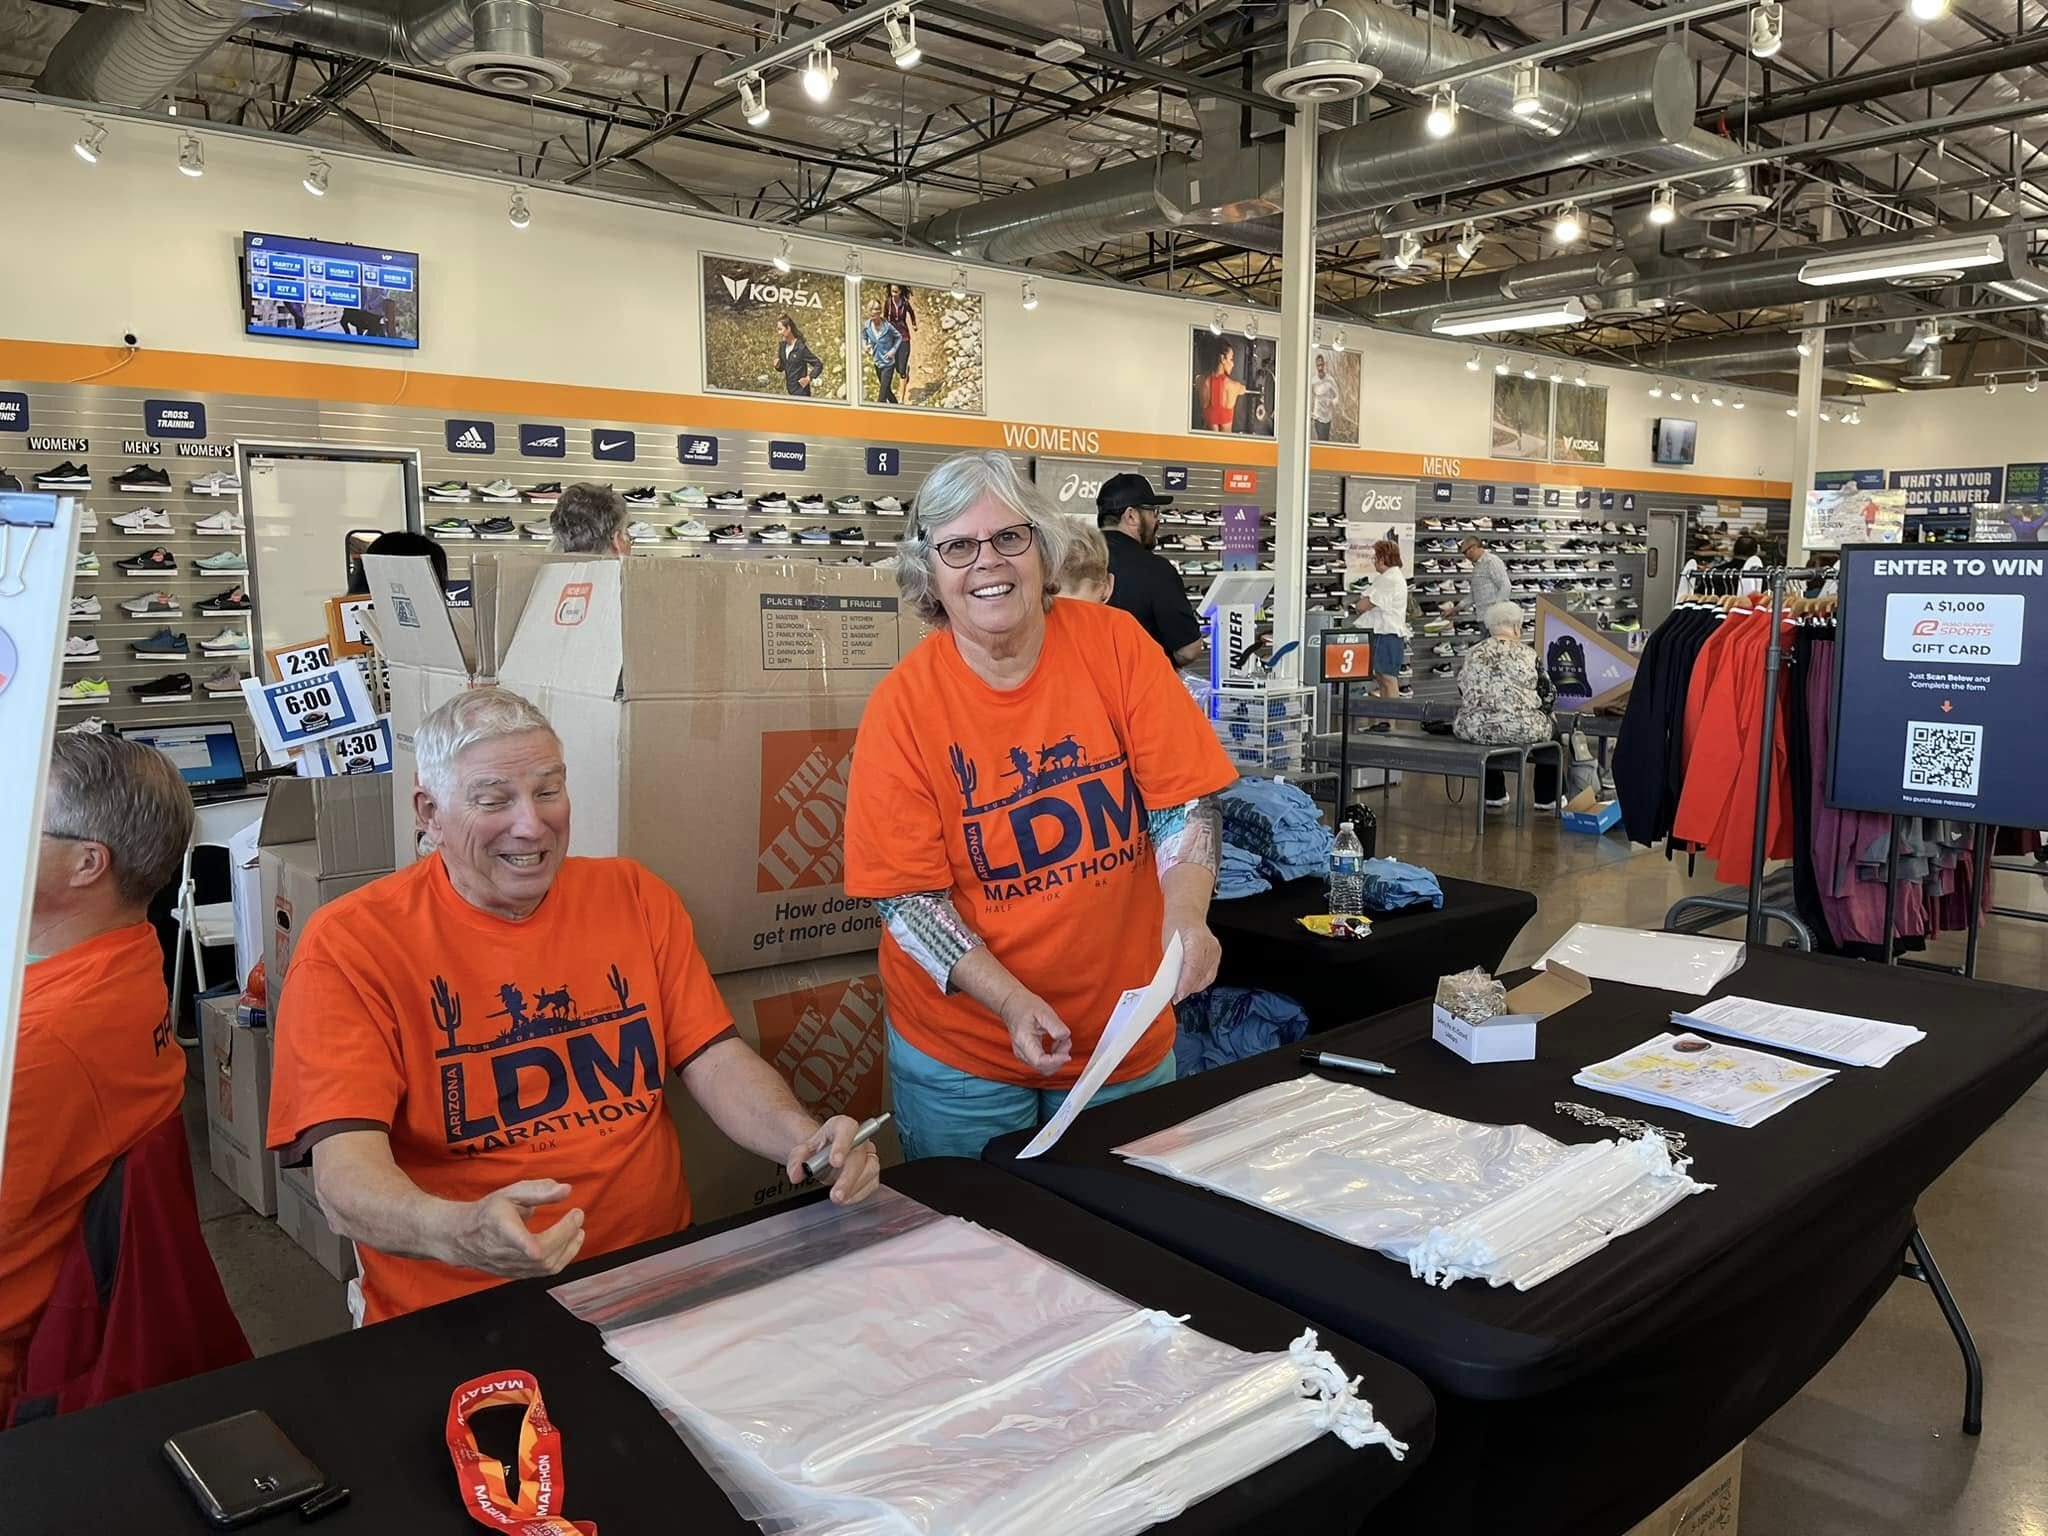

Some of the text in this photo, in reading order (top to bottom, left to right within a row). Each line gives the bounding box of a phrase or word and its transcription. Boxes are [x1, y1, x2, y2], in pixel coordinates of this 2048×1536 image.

[749, 283, 823, 309] KORSA
[157, 419, 195, 429] TRAINING
[161, 410, 190, 420] CROSS
[30, 437, 87, 452] WOMEN'S
[124, 441, 160, 454] MEN'S
[456, 438, 487, 450] adidas
[1003, 424, 1099, 454] WOMENS
[1571, 440, 1599, 452] KORSA
[179, 444, 232, 457] WOMEN'S
[772, 451, 804, 462] saucony
[1423, 457, 1460, 477] MENS
[1078, 480, 1102, 498] asi
[1900, 472, 1992, 488] WHAT'S IN YOUR
[1374, 495, 1402, 511] asics
[1934, 489, 1990, 504] DRAWER?
[1873, 559, 2044, 576] ENTER TO WIN
[767, 598, 793, 606] PLACE
[849, 600, 882, 608] FRAGILE
[1923, 600, 1985, 613] A $1,000
[1940, 627, 1992, 636] SPORTS
[1230, 611, 1242, 671] INDER
[1912, 644, 1991, 656] GIFT CARD
[287, 646, 330, 675] 2:30
[1340, 650, 1354, 674] 3
[1908, 672, 1925, 680] Just
[1926, 673, 1946, 681] Scan
[1948, 674, 1974, 682] Below
[1912, 680, 1986, 691] Complete the form
[285, 688, 332, 715] 6:00
[336, 734, 378, 758] 4:30
[774, 745, 833, 812] THE
[963, 767, 1151, 882] LDM
[970, 826, 990, 880] ARIZONA
[984, 844, 1135, 902] MARATHON
[1042, 892, 1060, 902] 10K
[776, 896, 872, 921] How doers
[984, 904, 1014, 914] HALF
[752, 928, 786, 950] get
[790, 920, 836, 942] more
[505, 1032, 534, 1044] FOR
[580, 1012, 619, 1026] GOLD
[774, 1004, 827, 1072] THE
[440, 1016, 663, 1145] LDM
[450, 1066, 462, 1136] ARIZONA
[599, 1126, 616, 1137] 8K
[530, 1138, 557, 1154] 10K
[752, 1179, 783, 1206] get
[456, 1379, 524, 1427] MARATN
[536, 1454, 550, 1518] MARATHON
[474, 1484, 516, 1525] MARATHO
